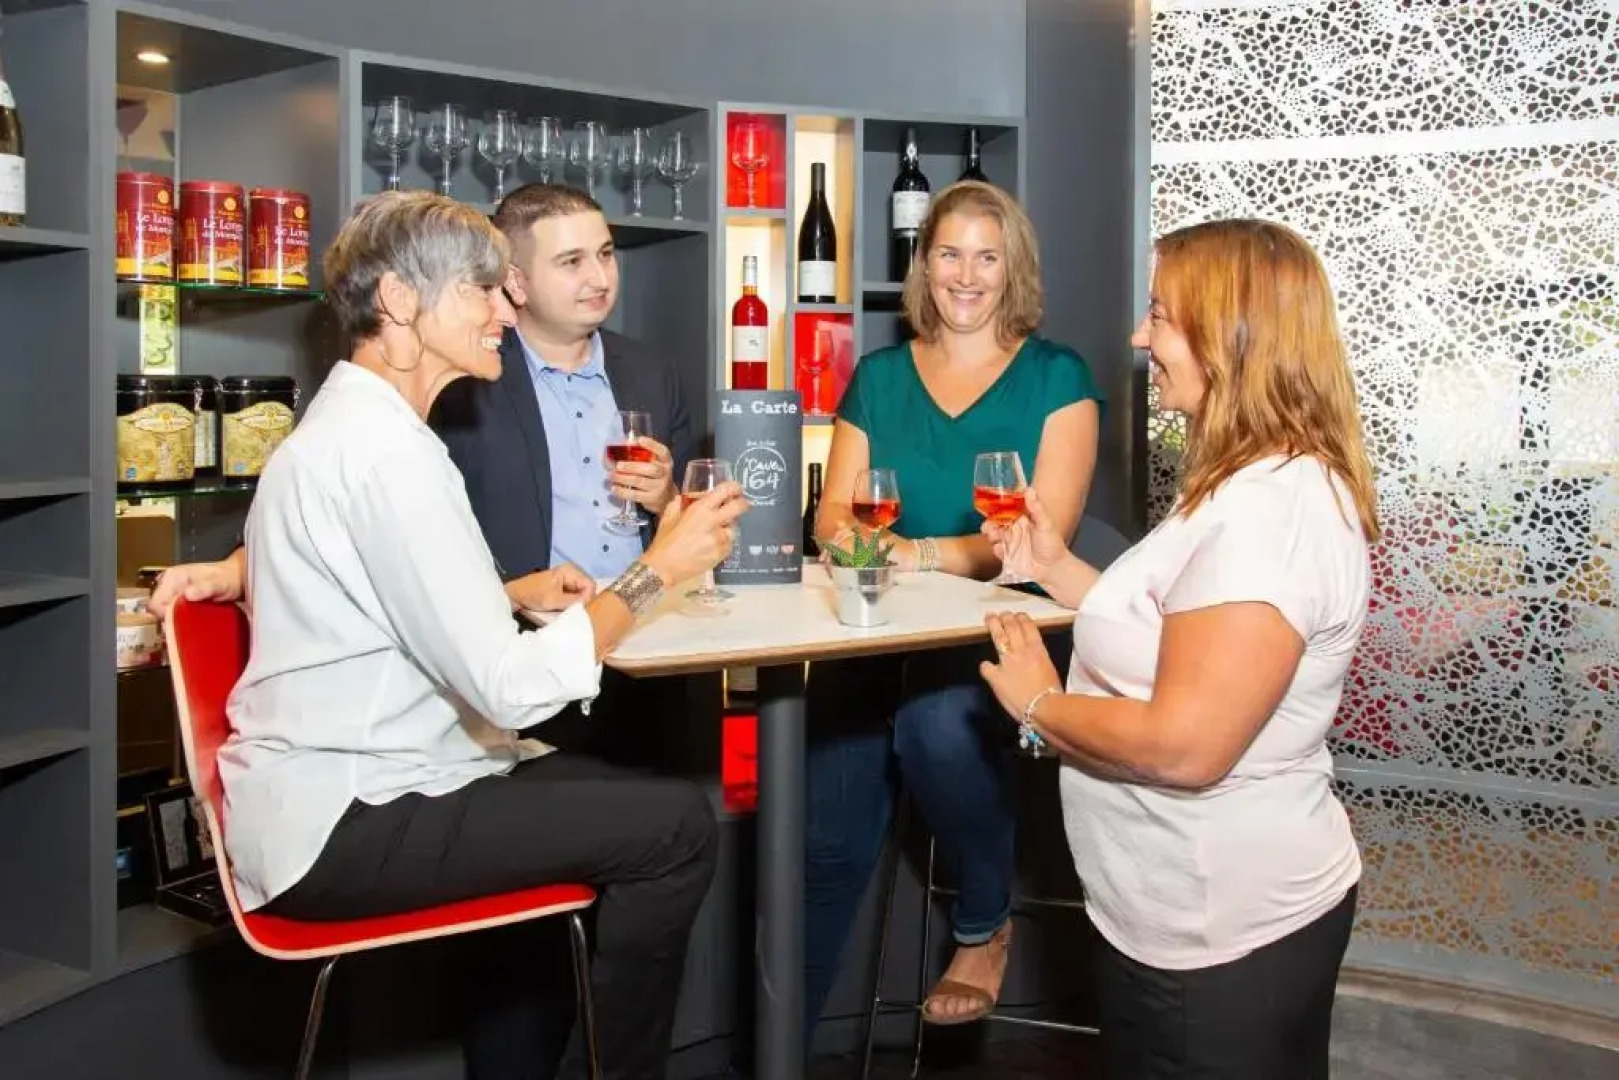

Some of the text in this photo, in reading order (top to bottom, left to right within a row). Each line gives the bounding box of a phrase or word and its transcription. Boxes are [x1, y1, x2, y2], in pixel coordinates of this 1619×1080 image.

[721, 400, 798, 414] La Carte
[743, 468, 780, 490] 164
